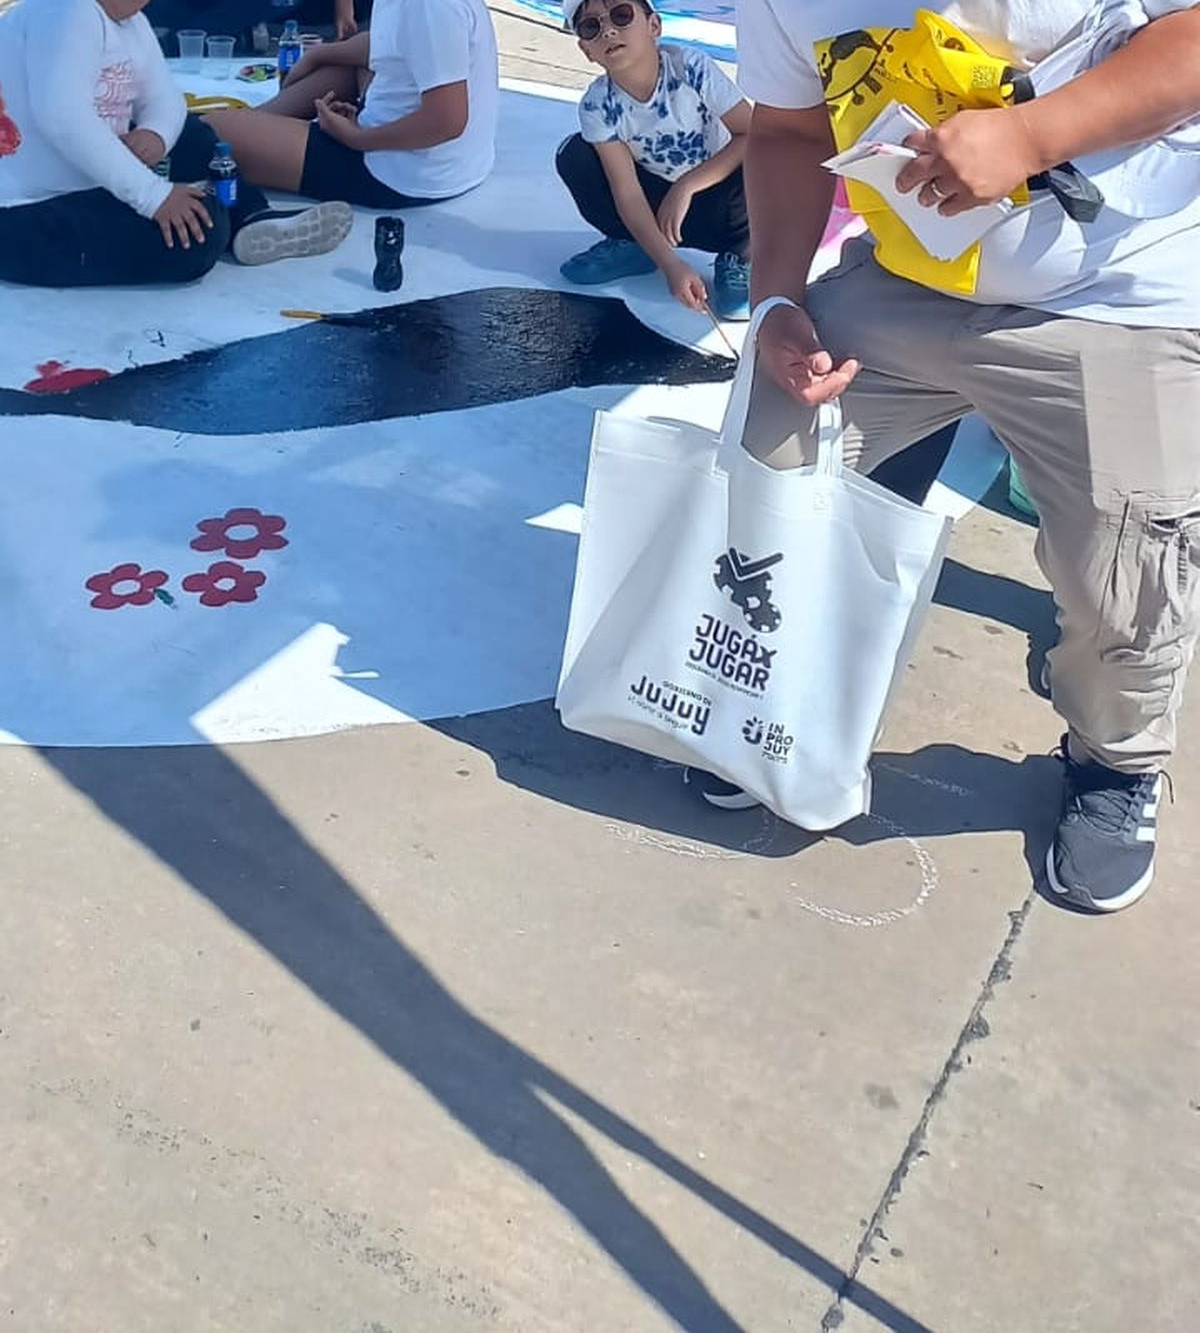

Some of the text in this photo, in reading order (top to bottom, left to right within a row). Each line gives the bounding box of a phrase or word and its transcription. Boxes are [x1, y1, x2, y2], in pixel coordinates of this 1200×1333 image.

[689, 637, 770, 692] JUGAR
[768, 722, 785, 735] IN
[766, 732, 794, 746] PRO
[763, 741, 791, 756] JUY
